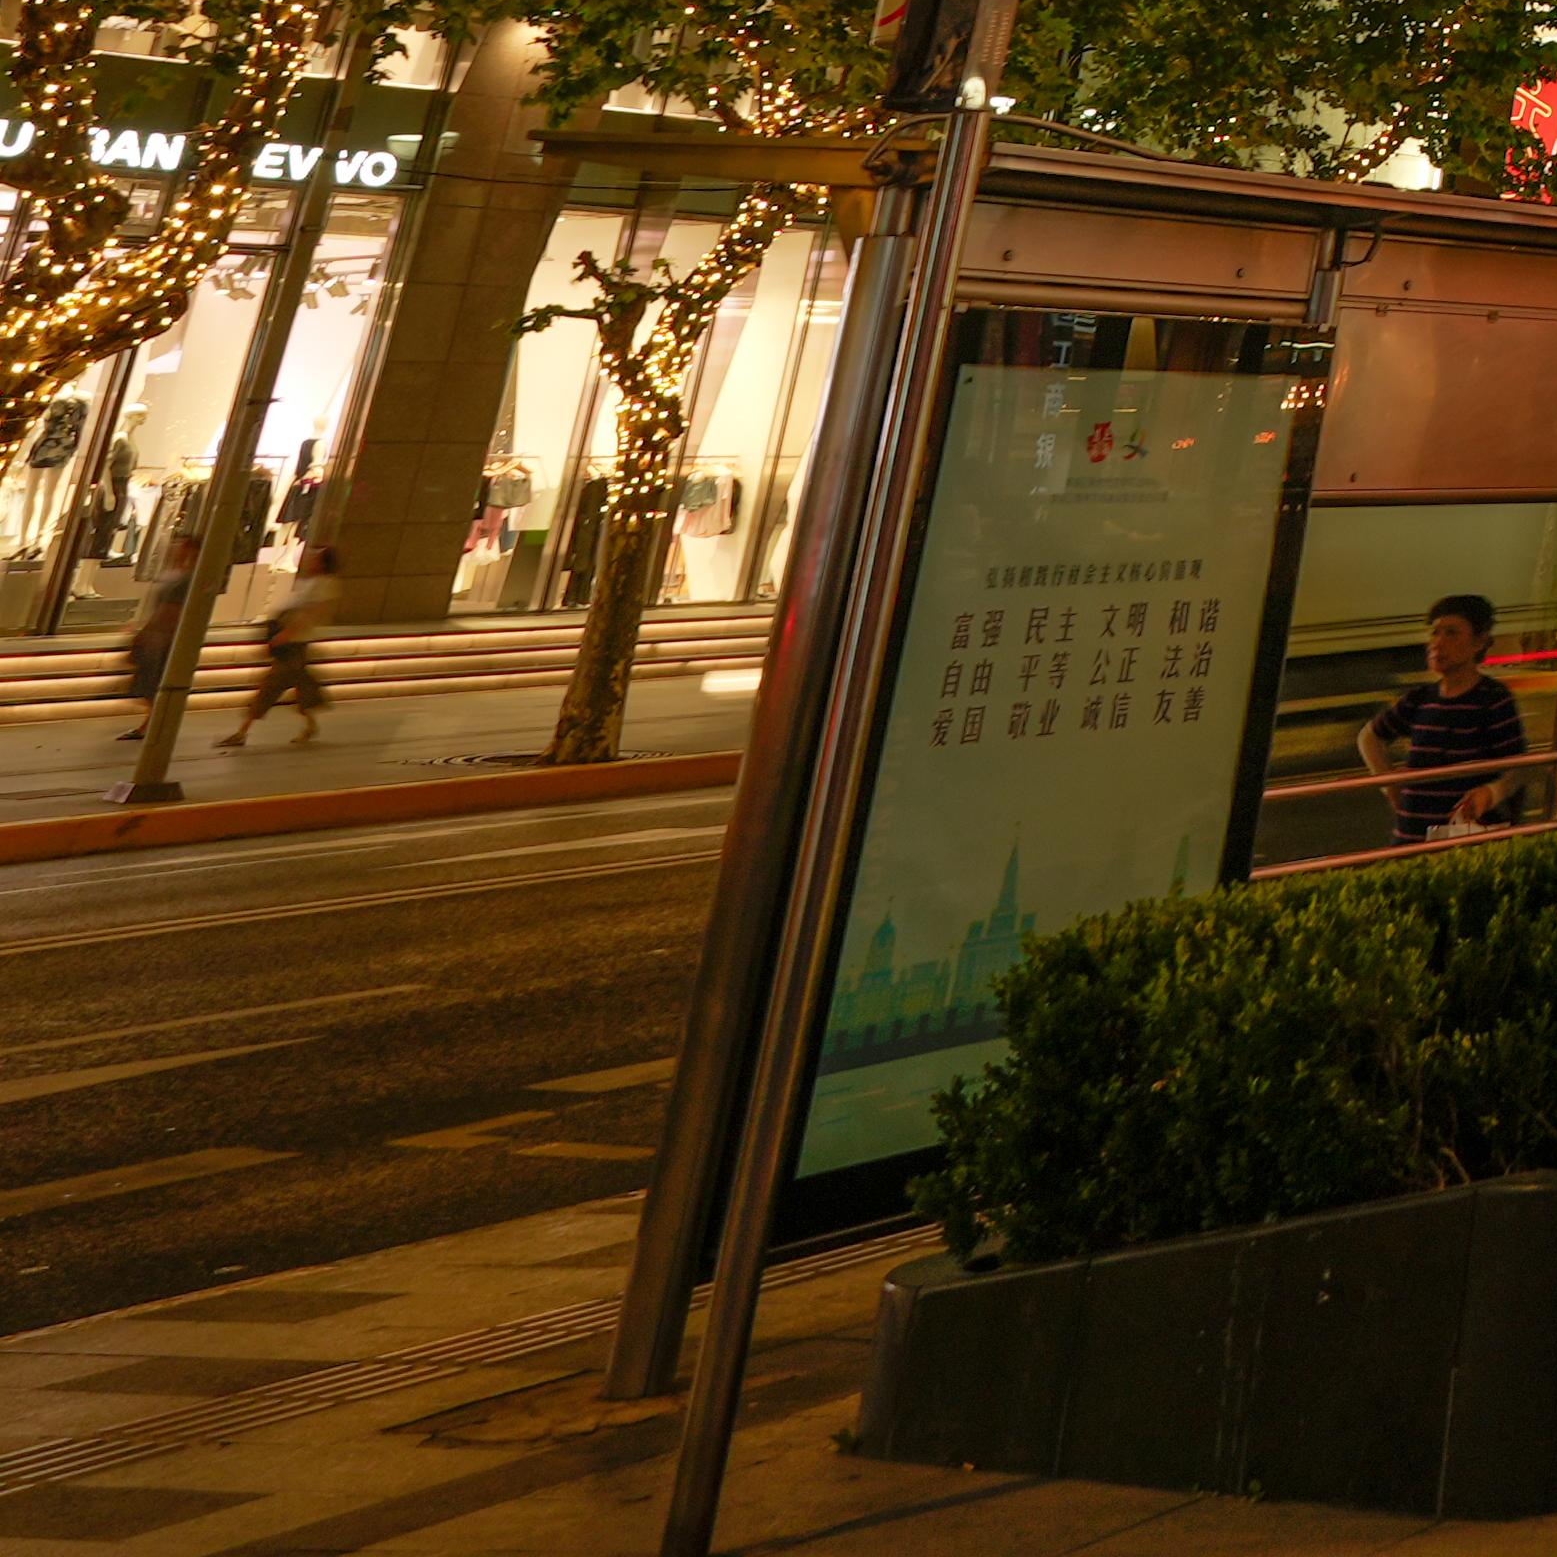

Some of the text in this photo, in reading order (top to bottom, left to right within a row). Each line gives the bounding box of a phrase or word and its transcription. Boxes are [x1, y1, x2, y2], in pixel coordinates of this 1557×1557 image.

[253, 143, 398, 187] EVVO
[951, 597, 1221, 651] 富强 民主 文明 和谐
[940, 640, 1213, 700] 自由 平等 公正 法治
[929, 685, 1205, 749] 爱国 敬业 诚信 友善
